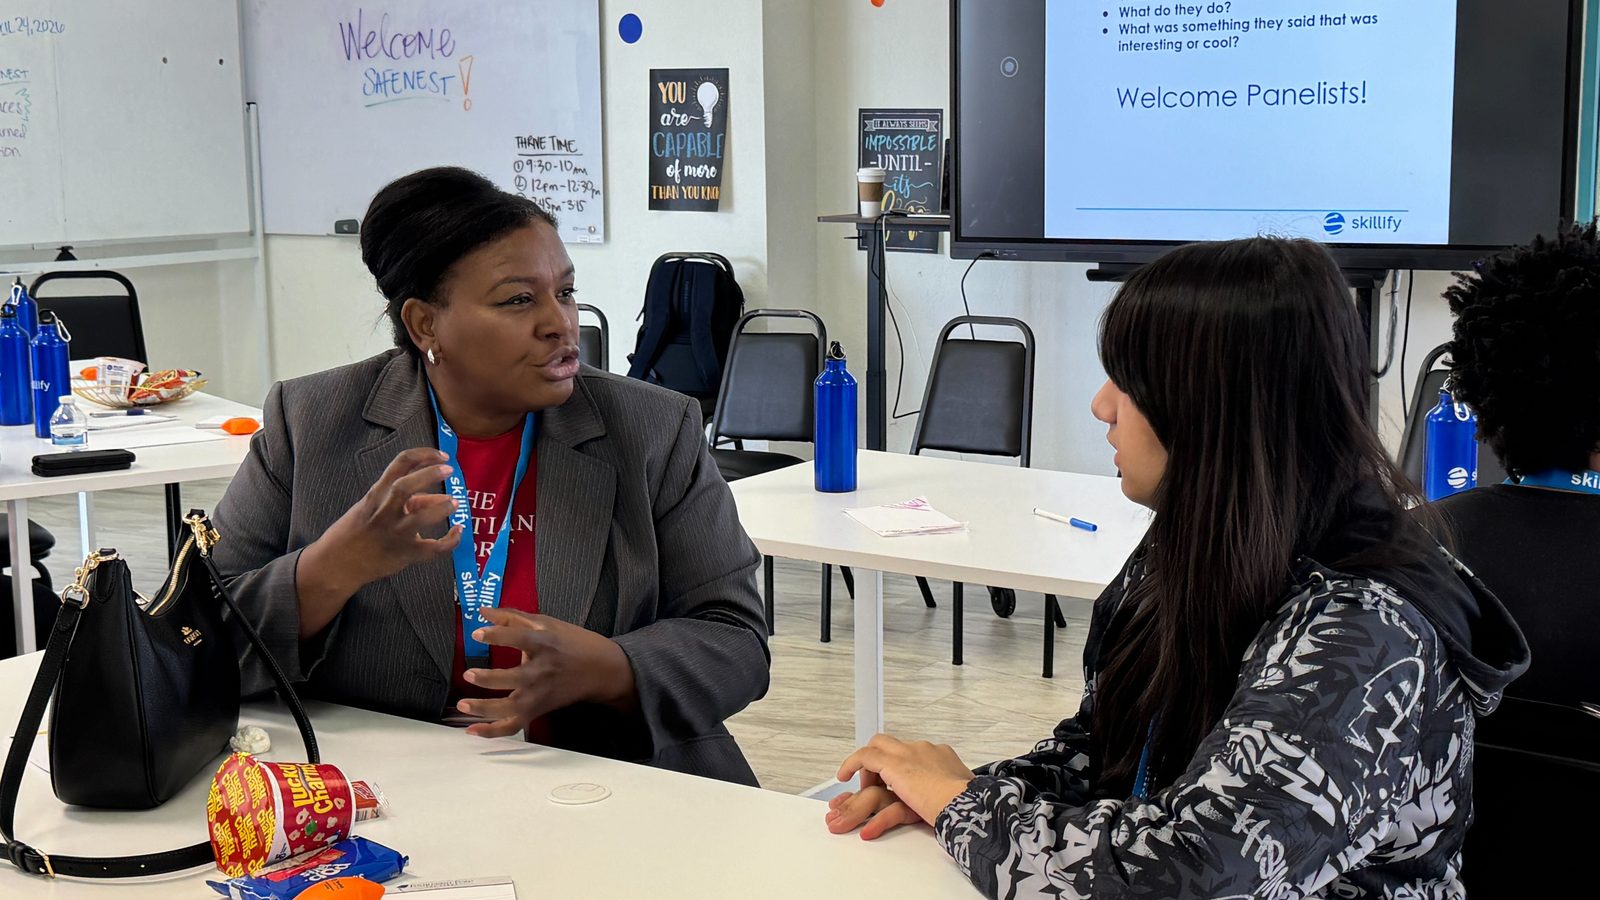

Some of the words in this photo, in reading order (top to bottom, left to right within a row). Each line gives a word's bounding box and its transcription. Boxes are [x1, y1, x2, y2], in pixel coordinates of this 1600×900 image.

[1119, 5, 1150, 18] What
[1154, 5, 1171, 16] do
[1175, 3, 1203, 17] they
[1206, 1, 1231, 14] do?
[339, 8, 455, 60] Welcome
[1119, 22, 1150, 35] What
[1154, 24, 1179, 33] was
[1182, 18, 1250, 32] something
[1254, 17, 1283, 31] they
[1287, 14, 1315, 28] said
[1320, 13, 1346, 26] that
[1350, 14, 1378, 25] was
[1118, 39, 1182, 52] interesting
[1187, 40, 1199, 49] or
[1203, 35, 1239, 49] cool?
[658, 81, 687, 104] YOU
[1117, 86, 1237, 109] Welcome
[1247, 80, 1367, 106] Panelists!
[660, 107, 691, 126] are
[548, 135, 578, 153] TIME
[652, 132, 724, 158] CAPABLE
[865, 134, 937, 151] IMPOSSIBLE
[666, 159, 680, 184] of
[684, 164, 717, 179] more
[652, 185, 679, 200] THAN
[682, 185, 700, 200] YOU
[1351, 215, 1402, 233] skillify
[1571, 472, 1600, 489] ski
[466, 489, 497, 511] HE
[471, 514, 535, 535] TIN
[230, 770, 246, 806] Lucky
[243, 766, 260, 809] Charms
[251, 762, 267, 799] Lucky
[222, 773, 238, 815] Charms
[221, 819, 236, 856] Lucky
[234, 815, 251, 859] Charms
[243, 812, 258, 850] Lucky
[213, 822, 229, 865] Charms
